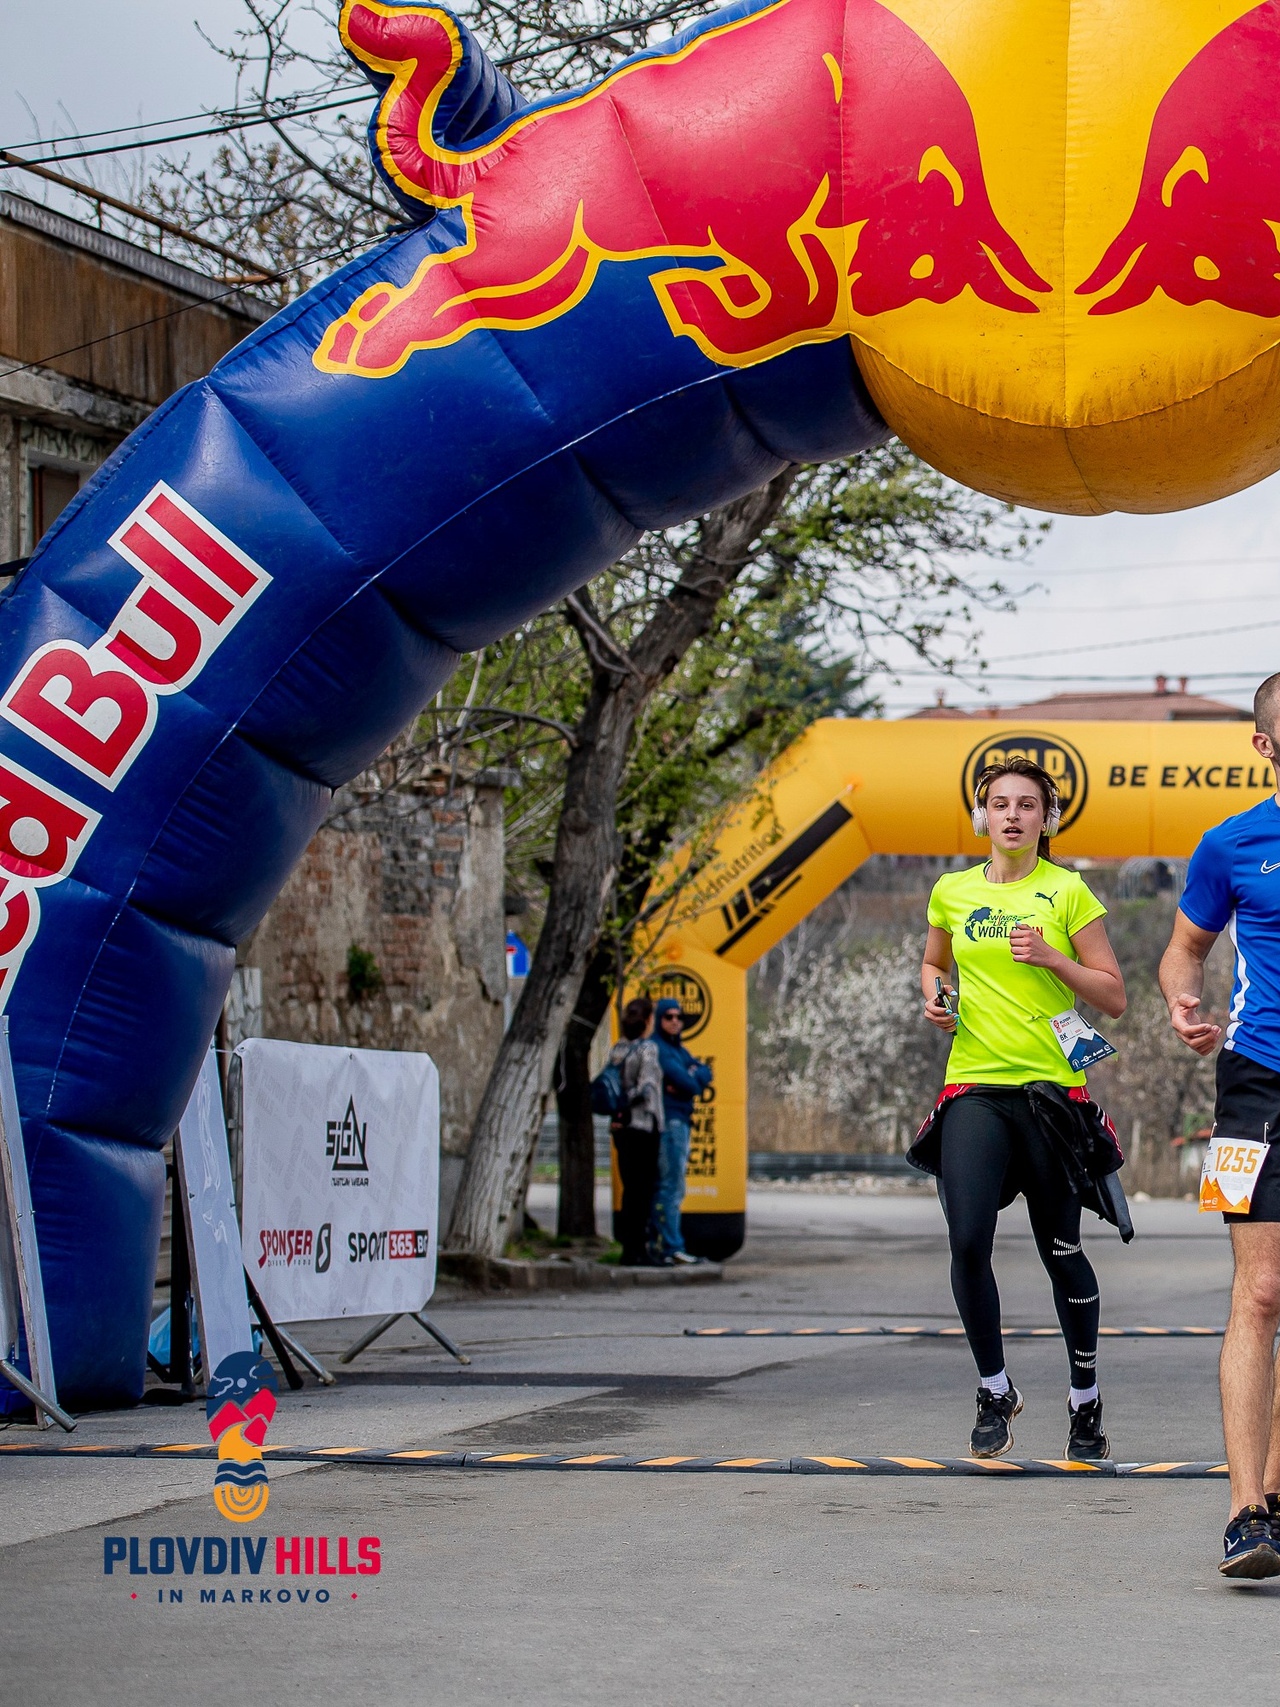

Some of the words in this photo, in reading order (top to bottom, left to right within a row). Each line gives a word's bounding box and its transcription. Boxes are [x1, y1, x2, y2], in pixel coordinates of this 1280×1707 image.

[6, 489, 262, 782] Bull
[1108, 765, 1149, 787] BE
[1160, 765, 1276, 788] EXCELL
[1215, 1146, 1261, 1174] 1255
[258, 1229, 313, 1269] SPONSER
